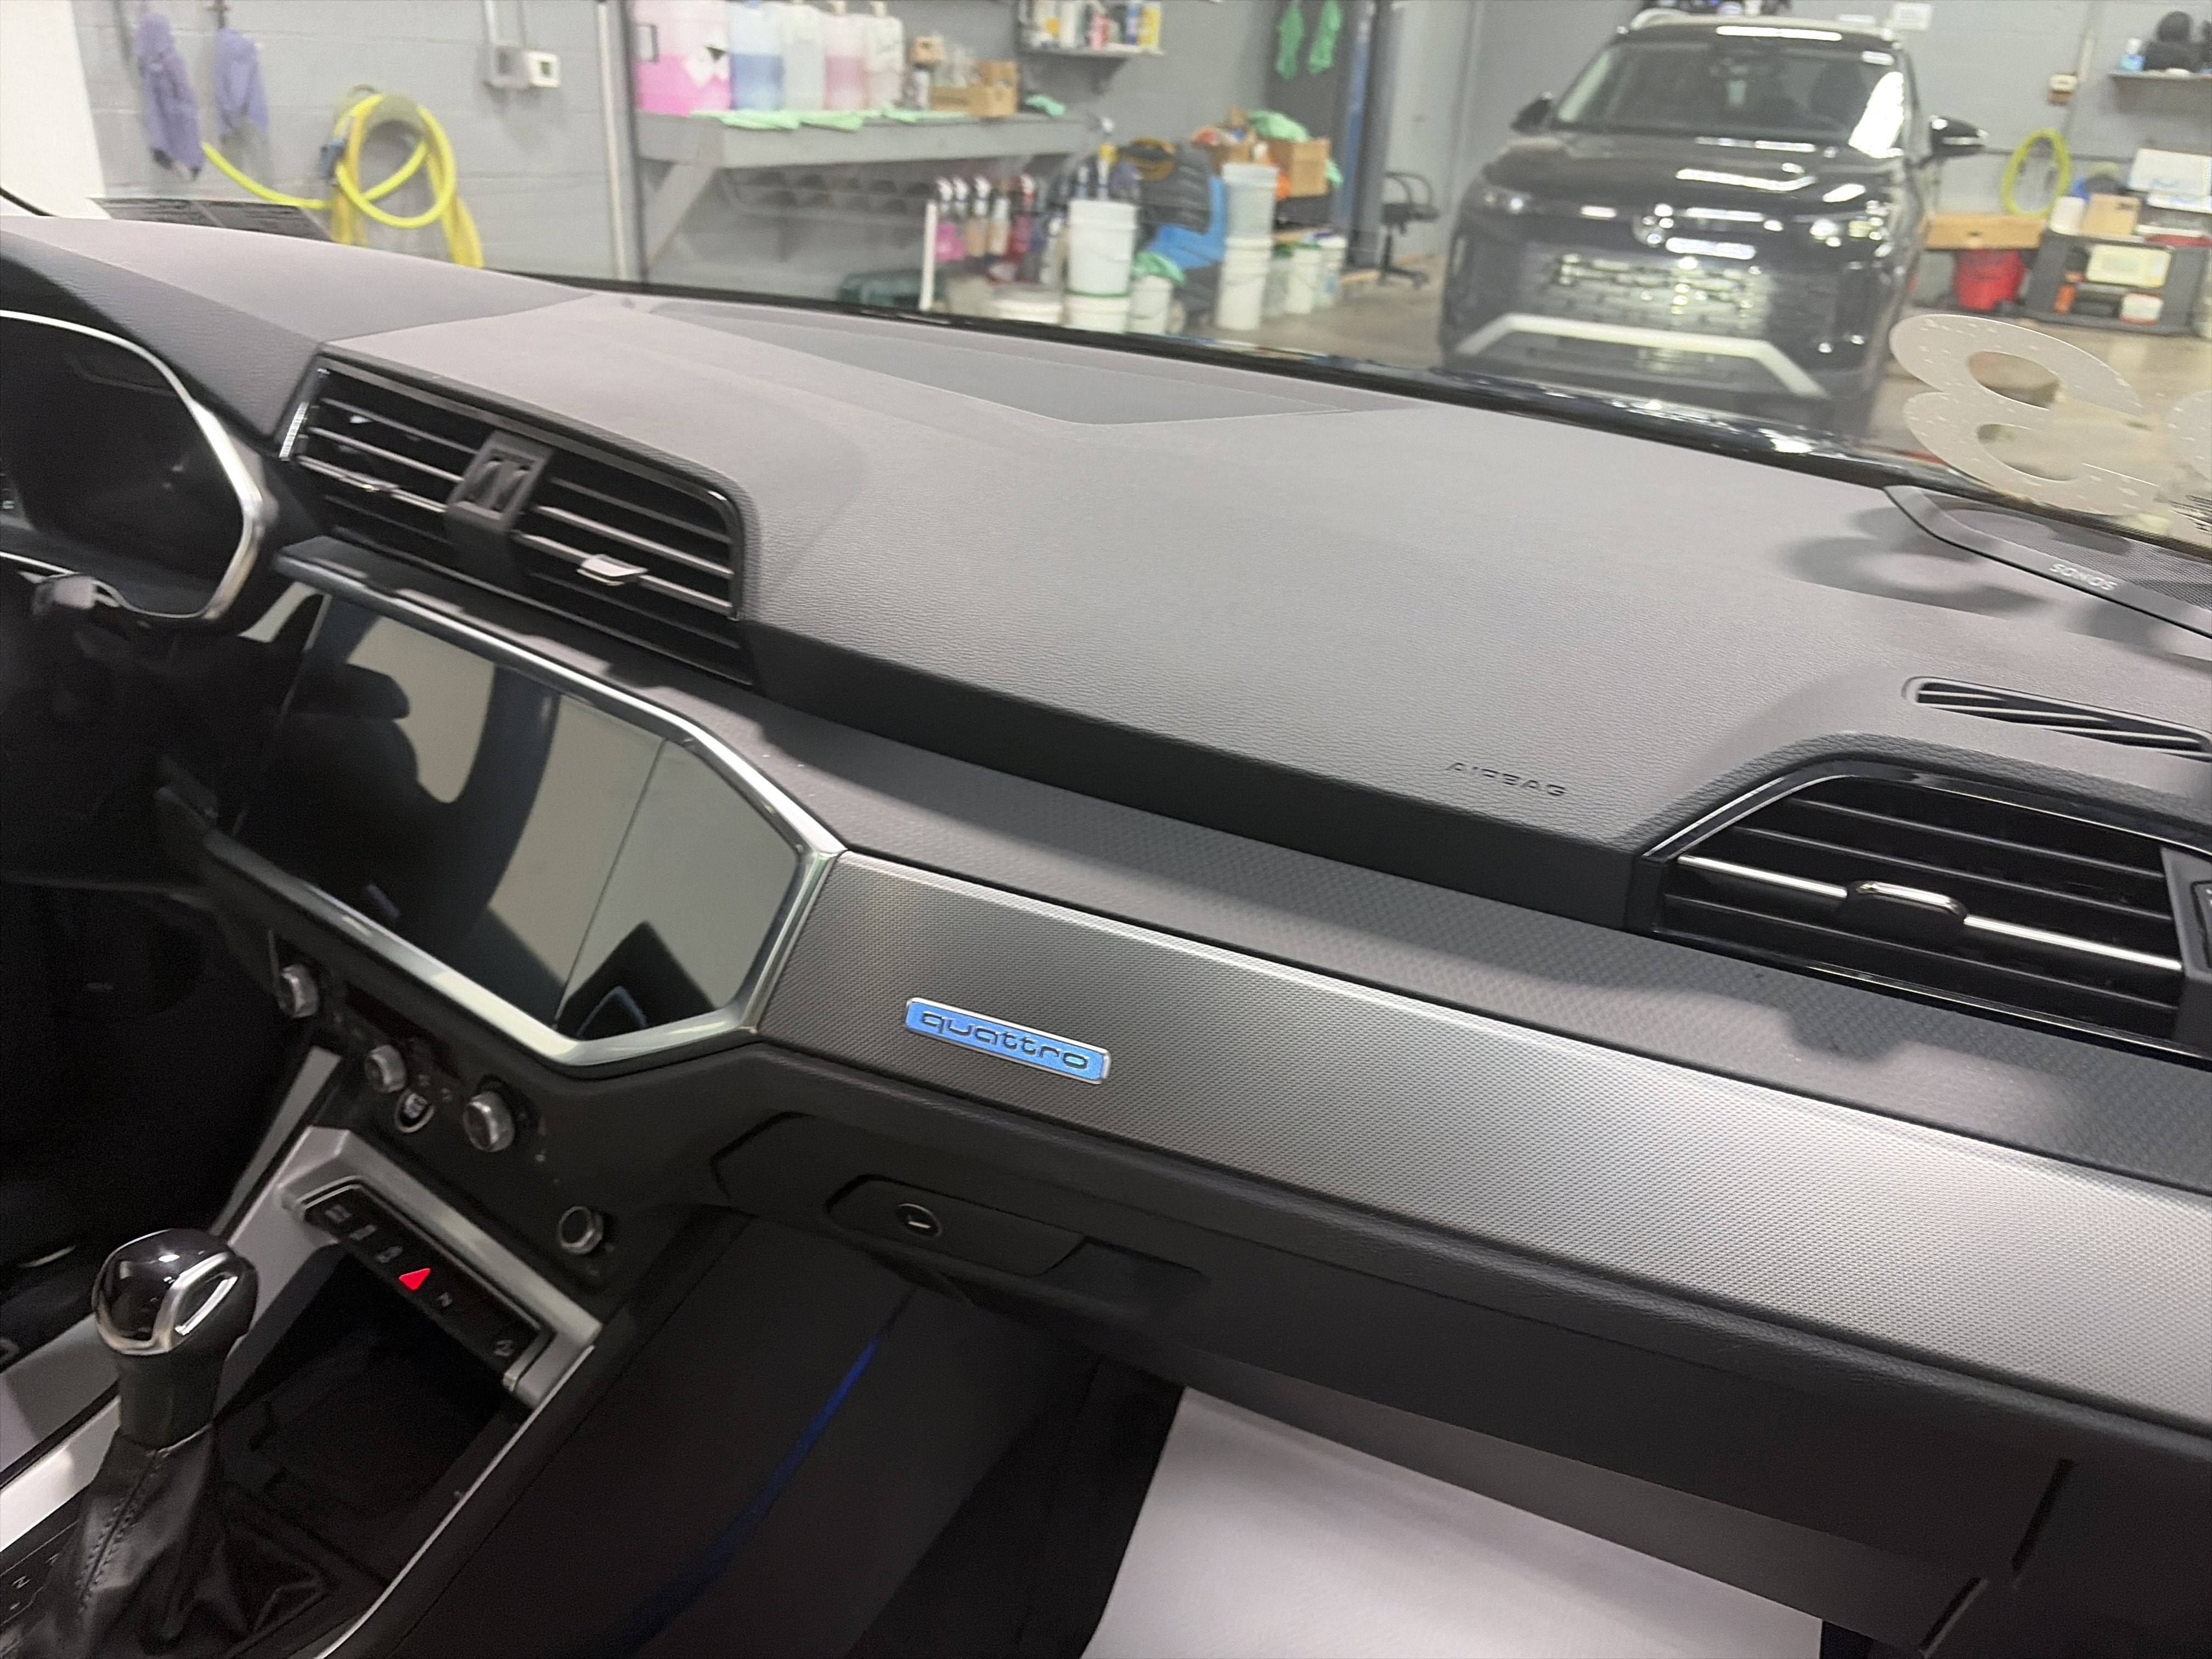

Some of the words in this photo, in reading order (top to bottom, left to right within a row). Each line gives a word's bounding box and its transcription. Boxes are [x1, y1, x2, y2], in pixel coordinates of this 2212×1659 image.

[2049, 563, 2118, 591] SONOS
[1446, 762, 1566, 797] AIRBAG
[921, 1010, 1090, 1071] quattro
